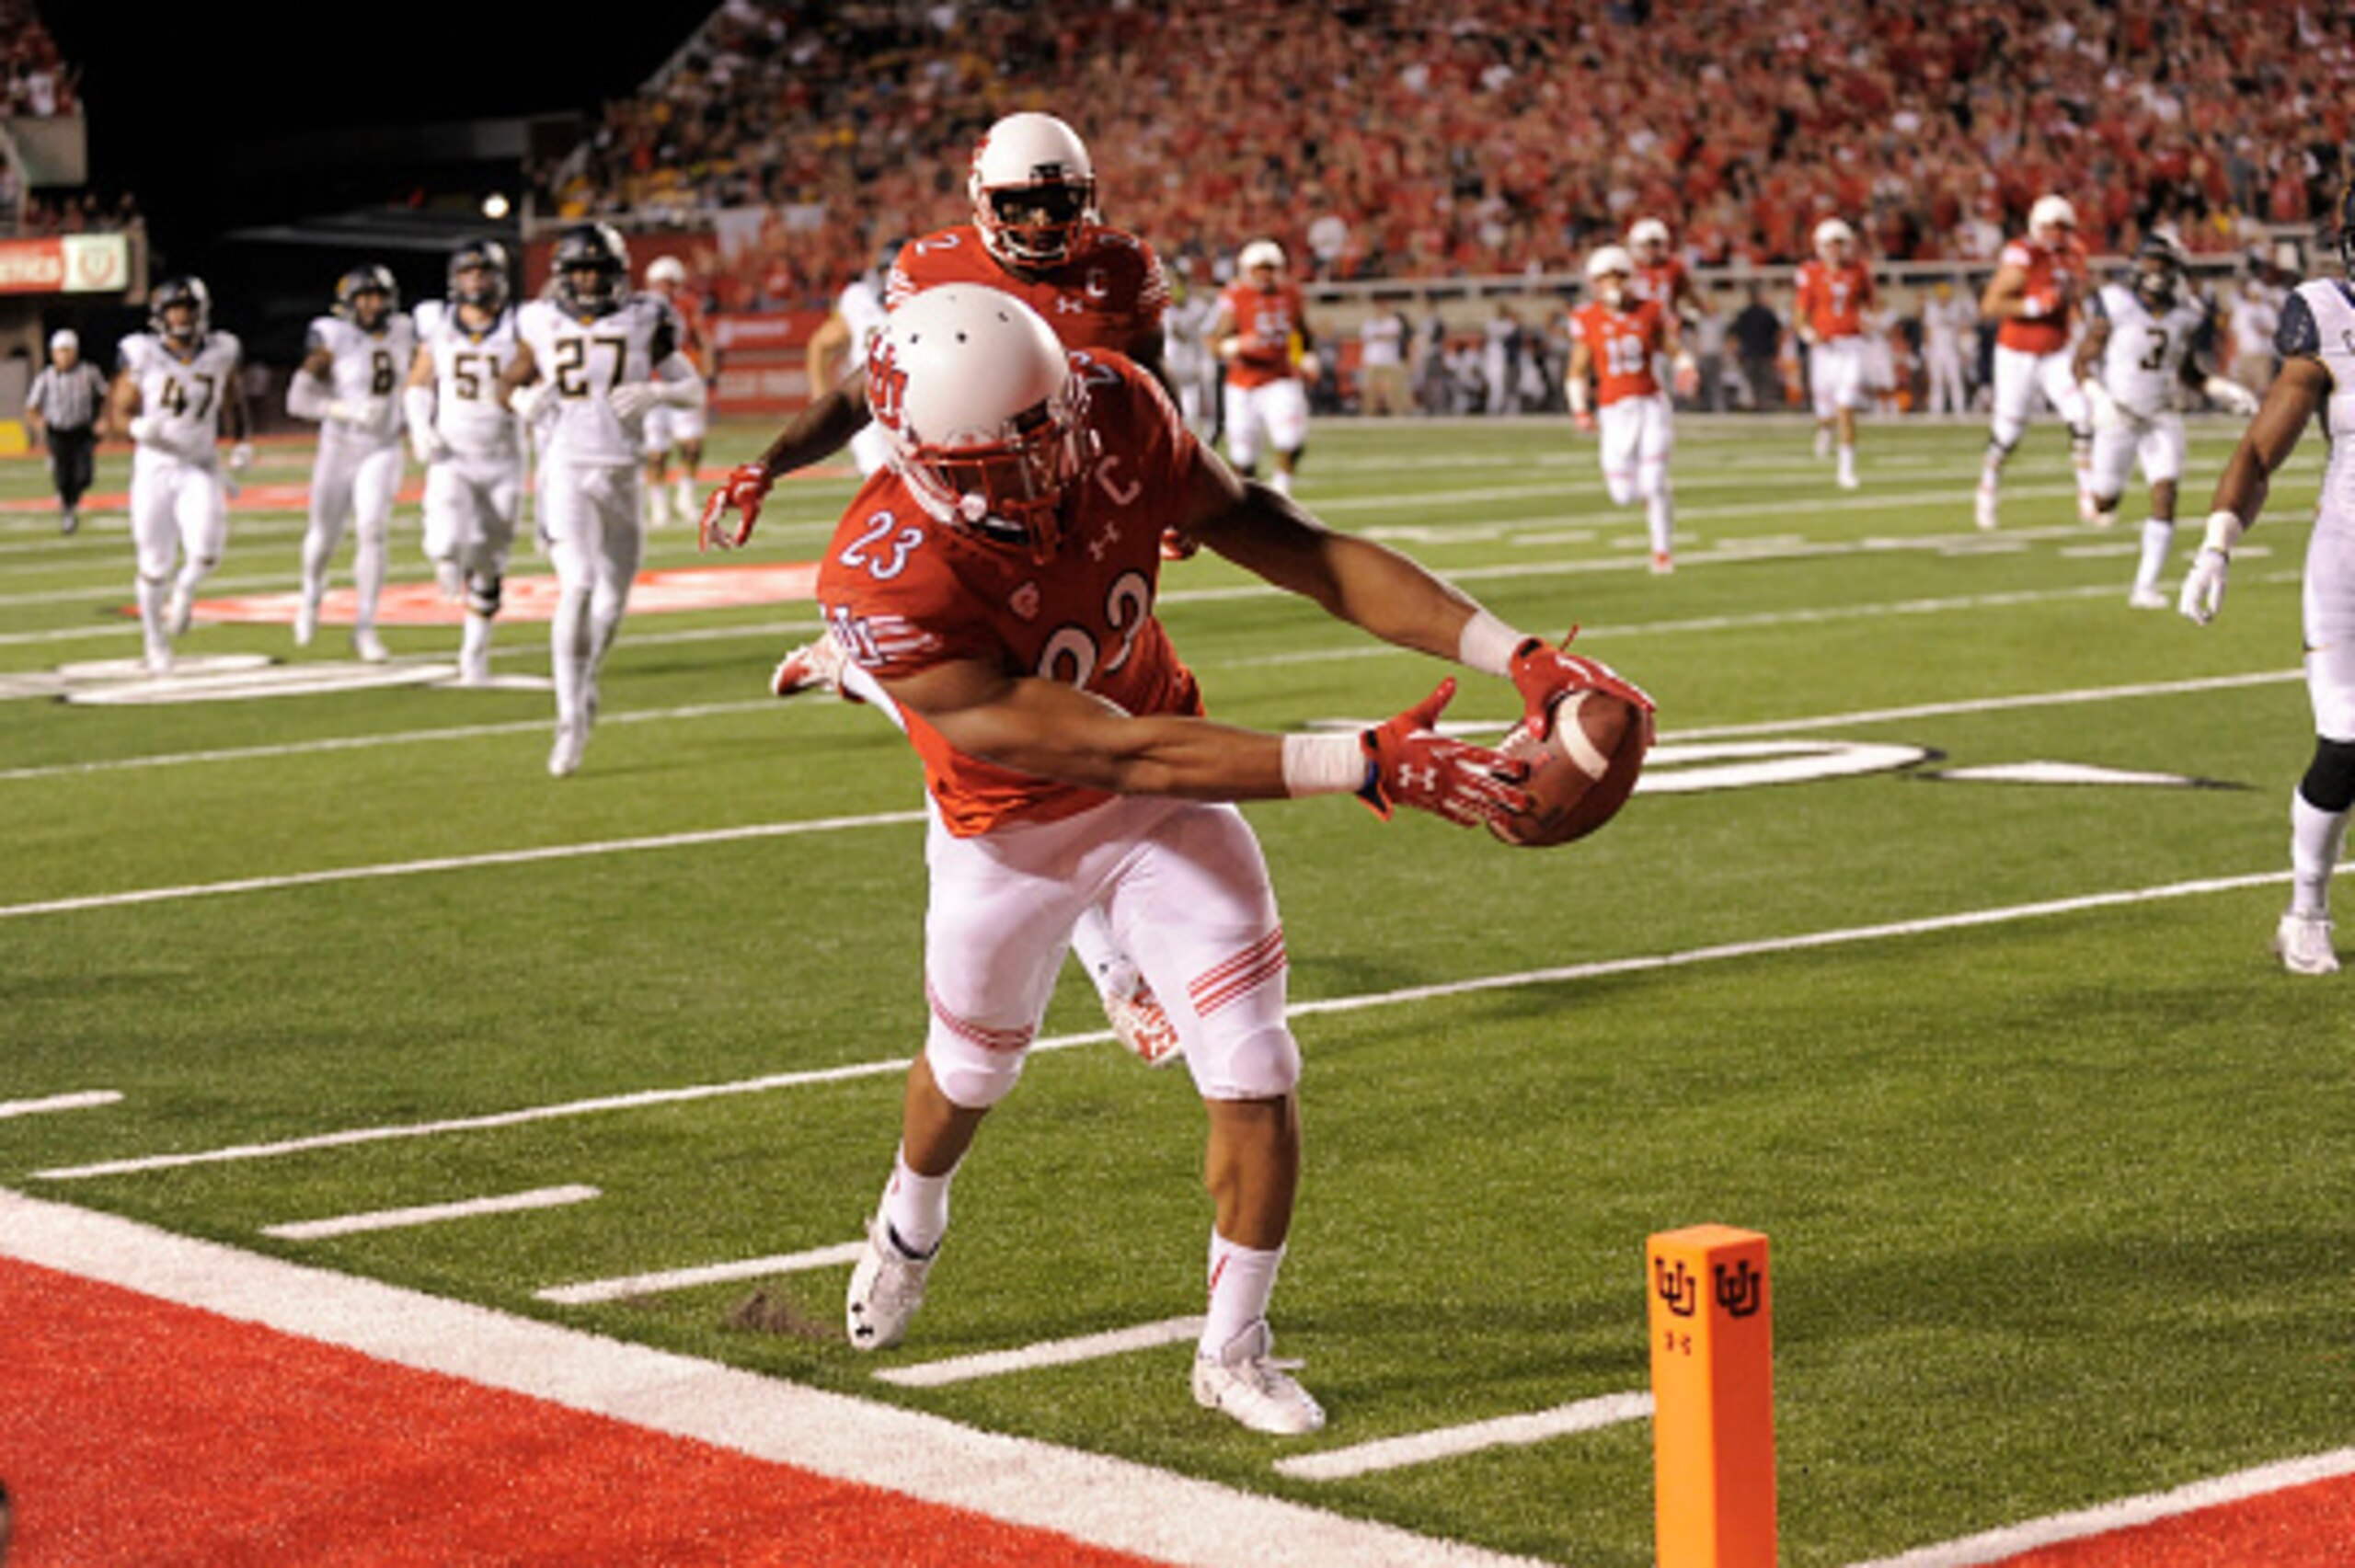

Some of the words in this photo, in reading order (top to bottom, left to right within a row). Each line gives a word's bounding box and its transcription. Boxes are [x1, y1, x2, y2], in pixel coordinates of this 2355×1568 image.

[554, 334, 627, 399] 27
[2140, 327, 2169, 371] 3
[159, 371, 216, 421] 47
[1096, 454, 1142, 506] C
[838, 509, 926, 581] 23
